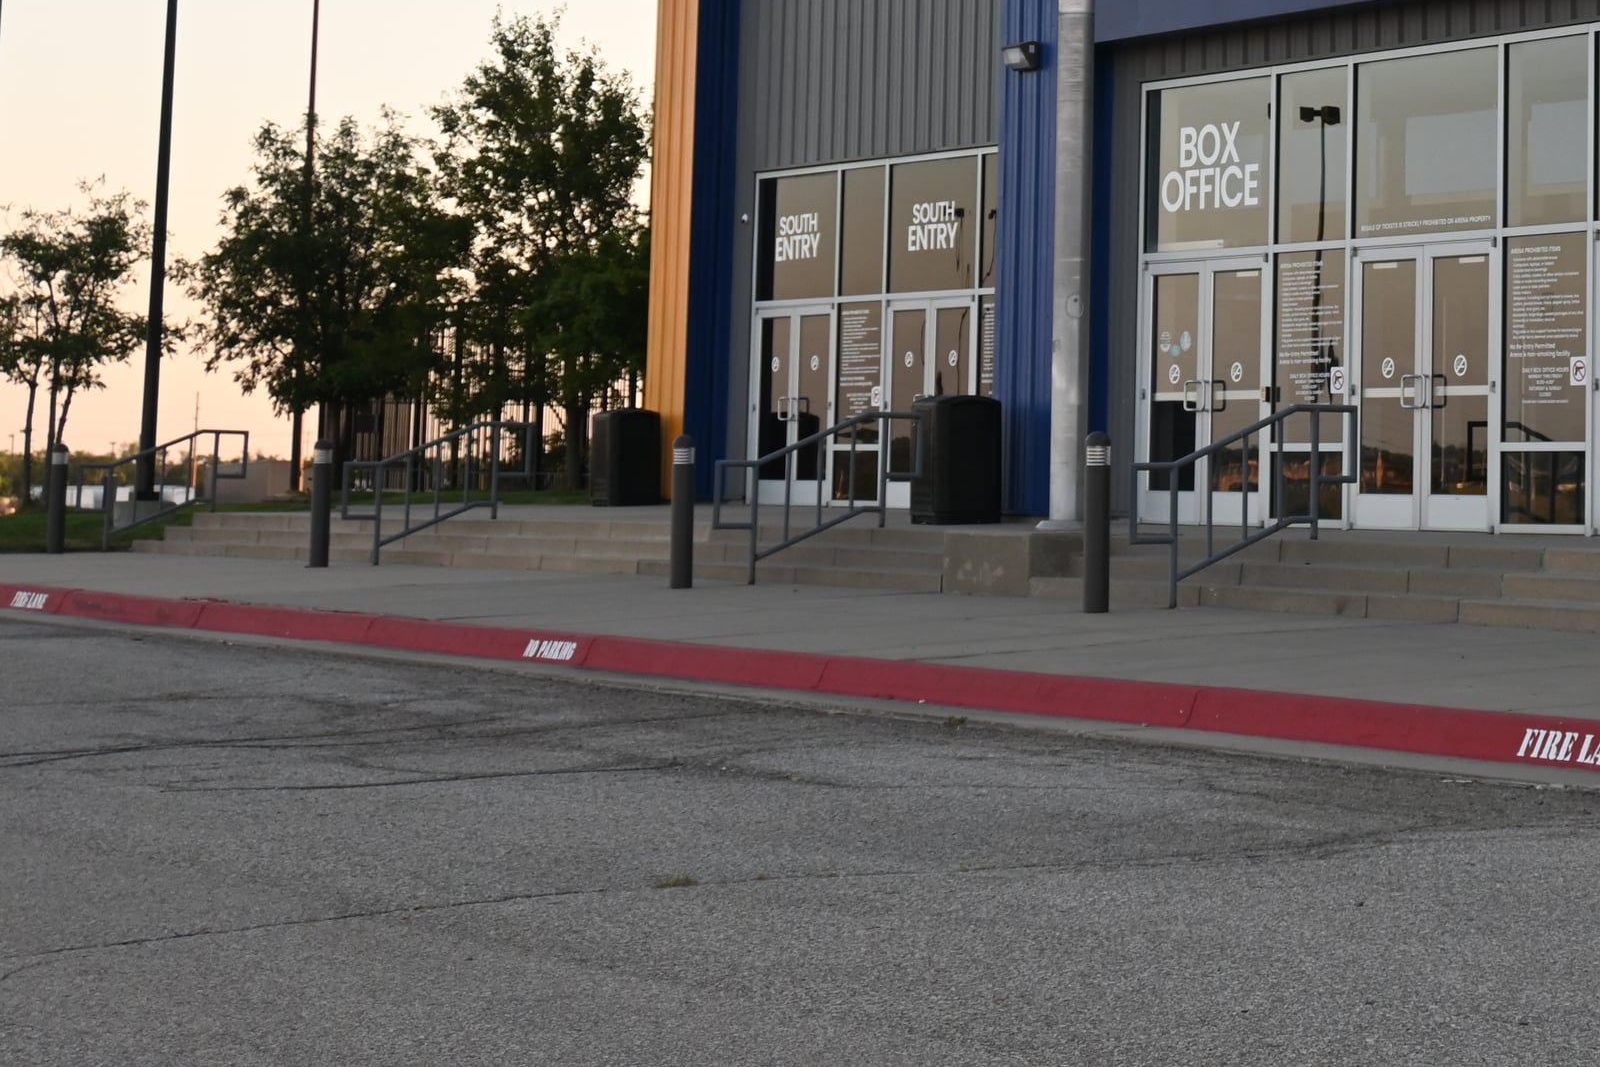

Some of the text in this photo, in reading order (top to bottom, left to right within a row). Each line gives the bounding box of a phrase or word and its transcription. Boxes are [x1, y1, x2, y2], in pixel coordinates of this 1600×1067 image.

[1180, 122, 1240, 167] BOX
[1162, 164, 1258, 212] OFFICE
[780, 213, 817, 235] SOUTH
[913, 201, 955, 224] SOUTH
[776, 233, 820, 261] ENTRY
[908, 222, 958, 251] ENTRY
[1517, 729, 1578, 761] FIRE
